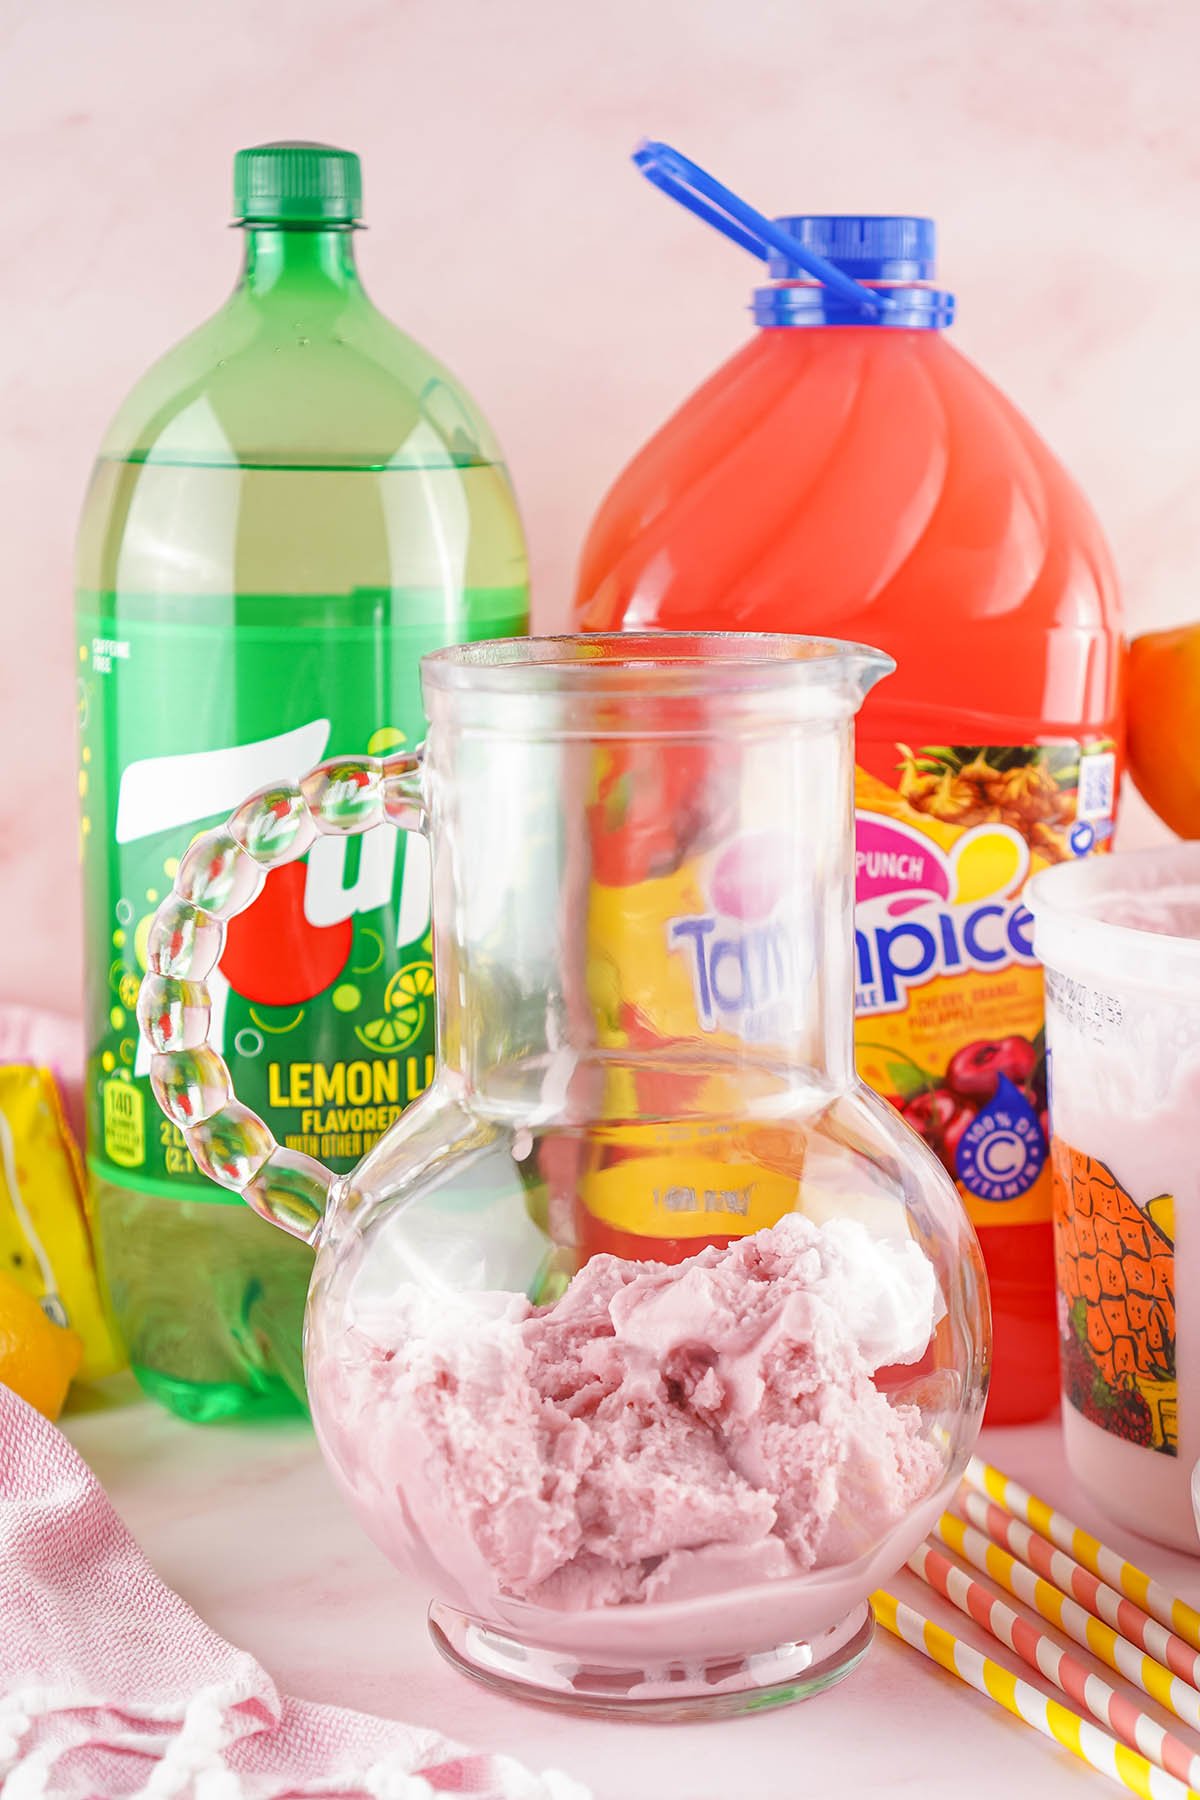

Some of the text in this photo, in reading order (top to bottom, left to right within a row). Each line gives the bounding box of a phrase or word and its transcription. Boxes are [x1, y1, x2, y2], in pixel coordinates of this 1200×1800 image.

[856, 851, 924, 882] PUNCH
[269, 1059, 398, 1107] LEMON
[110, 1088, 132, 1118] 140
[965, 1111, 1039, 1144] 100% DV
[286, 1135, 319, 1157] WITH
[321, 1132, 361, 1157] OTHER
[983, 1136, 1016, 1177] C
[962, 1163, 1039, 1199] VITAMIN
